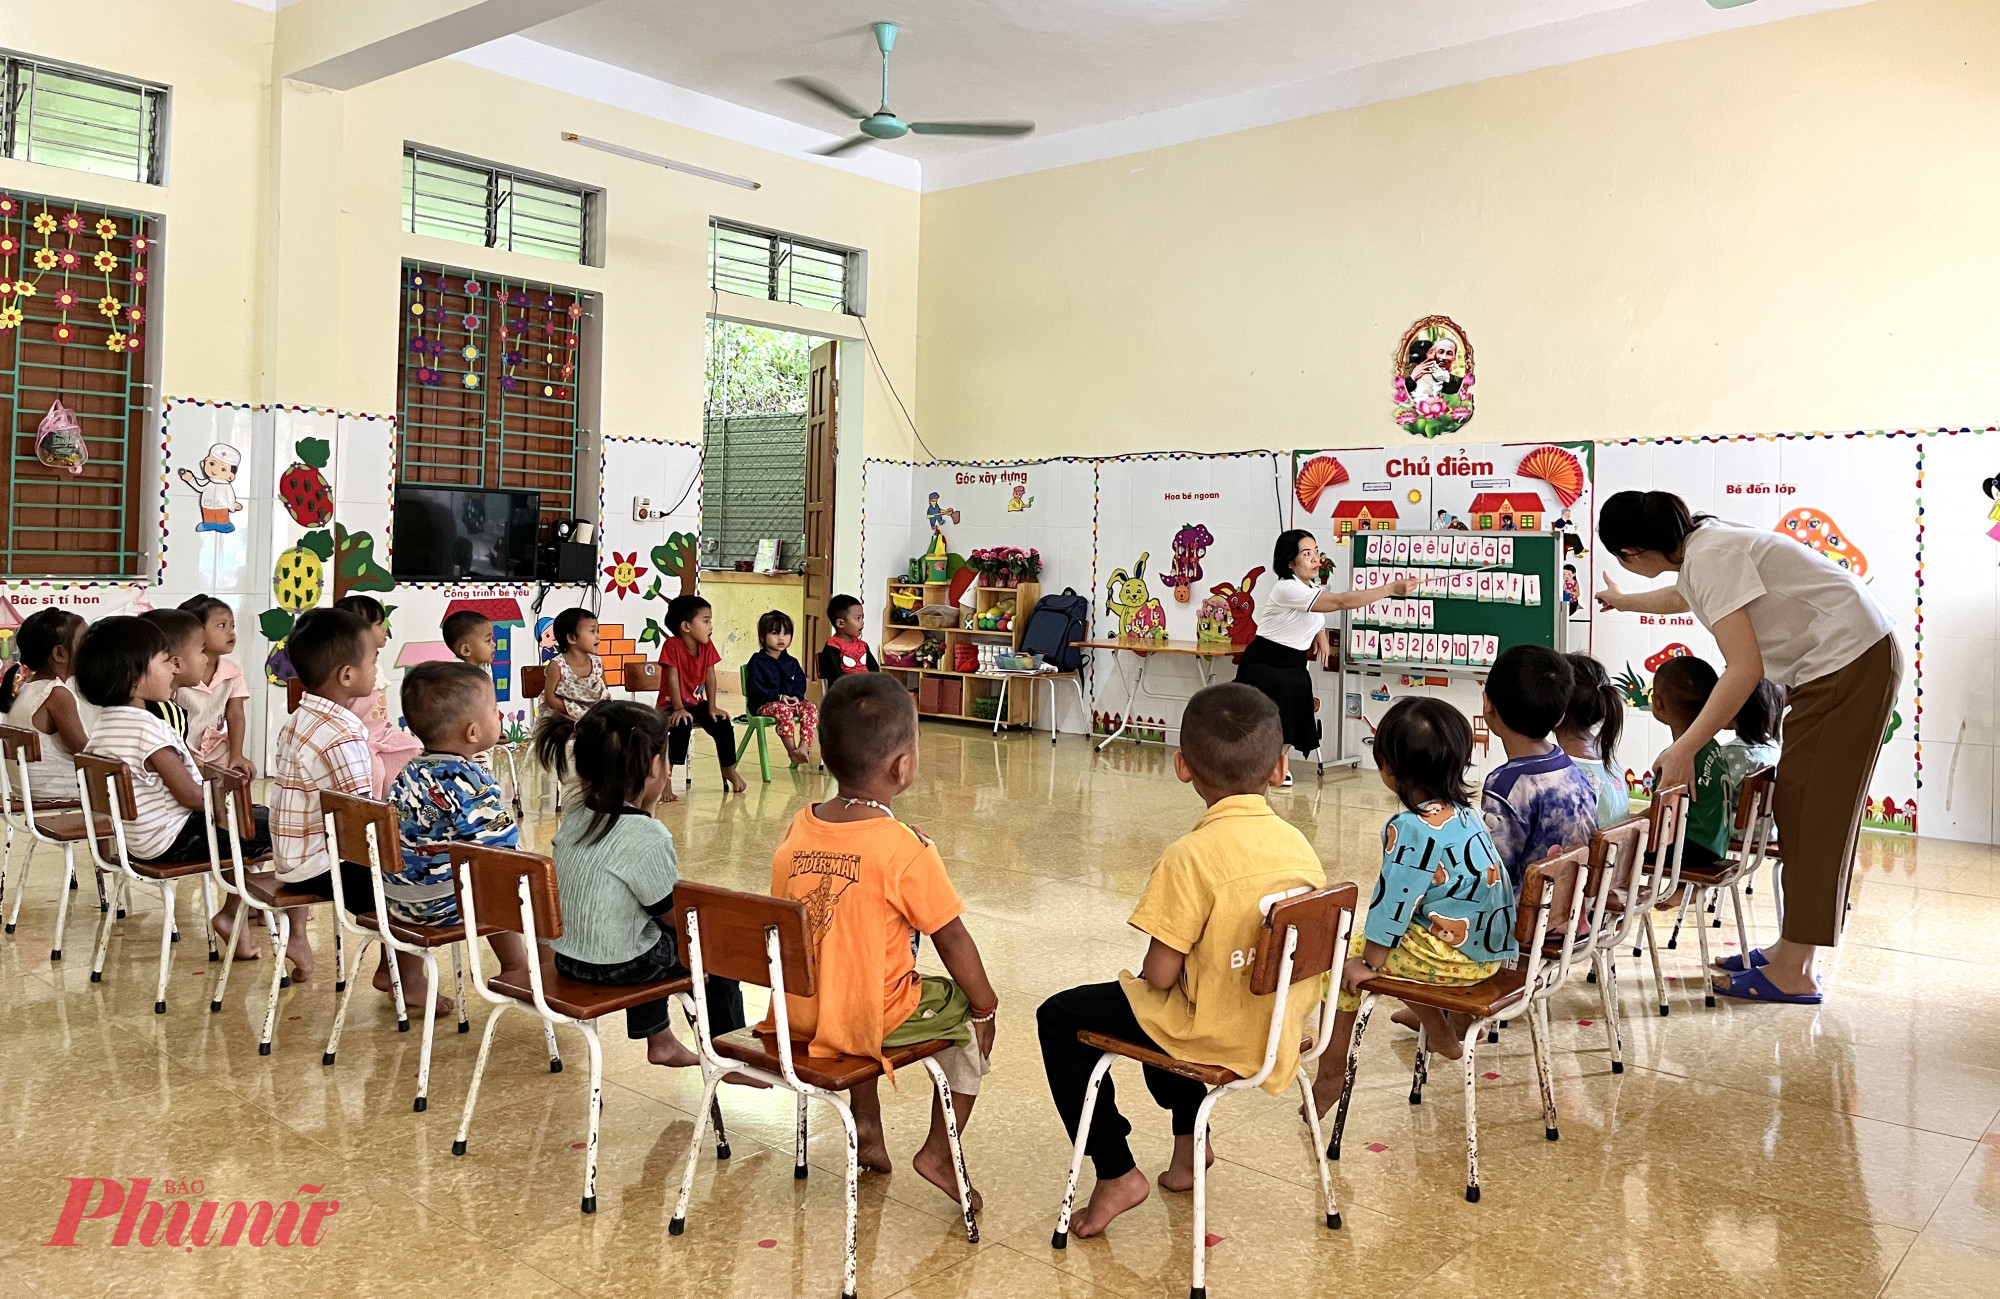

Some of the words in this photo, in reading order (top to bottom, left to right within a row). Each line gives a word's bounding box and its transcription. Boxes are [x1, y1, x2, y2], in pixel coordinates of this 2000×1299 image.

[1386, 456, 1430, 477] Chủ
[1436, 448, 1493, 476] điểm
[955, 472, 976, 484] Góc
[979, 471, 997, 485] xây
[1001, 470, 1027, 486] dựng
[1726, 484, 1742, 494] Bé
[1746, 482, 1770, 494] đến
[1775, 484, 1796, 495] lớp
[1182, 491, 1192, 500] bé
[1194, 492, 1220, 501] ngoan
[11, 595, 37, 604] Bác
[42, 594, 55, 604] sĩ
[59, 595, 69, 604] tí
[74, 595, 100, 604] hon
[444, 589, 469, 599] Công
[1640, 615, 1655, 625] Bé
[1659, 614, 1666, 625] ở
[1670, 616, 1693, 625] nhà
